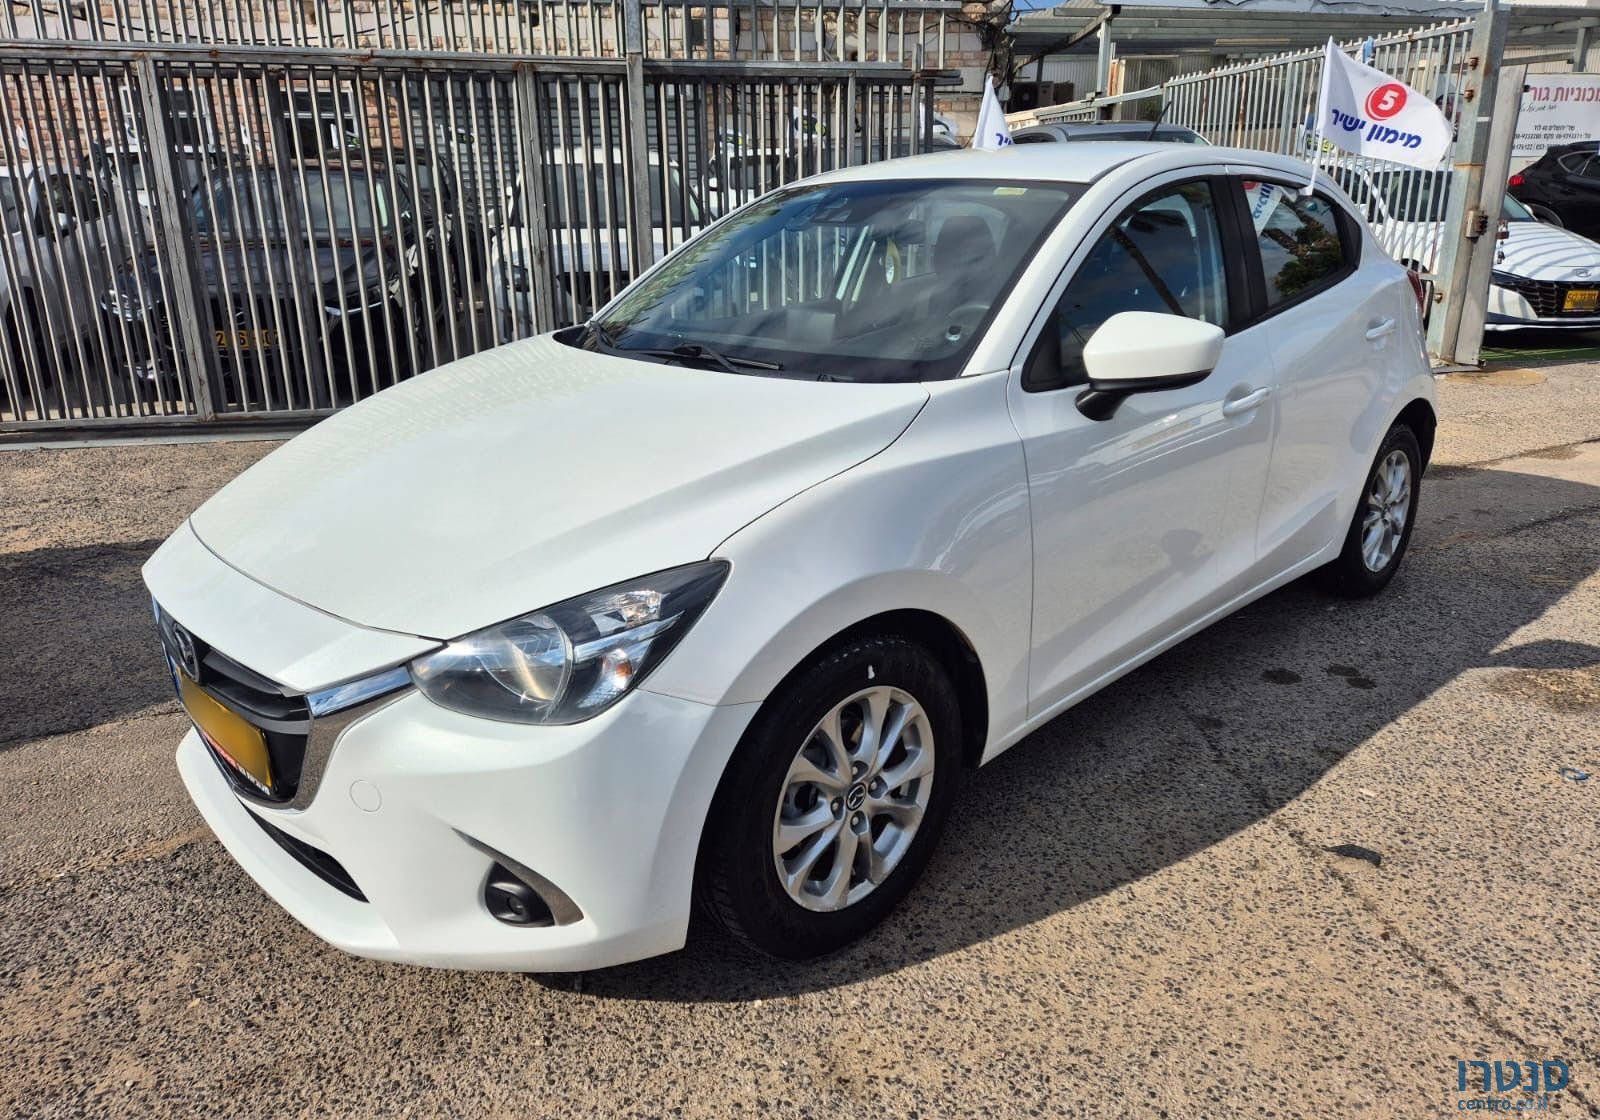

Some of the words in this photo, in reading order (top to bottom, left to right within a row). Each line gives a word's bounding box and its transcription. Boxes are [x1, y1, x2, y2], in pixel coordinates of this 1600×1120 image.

[1377, 90, 1399, 111] 5
[1332, 109, 1366, 131] ישיר
[1366, 124, 1421, 149] מימון
